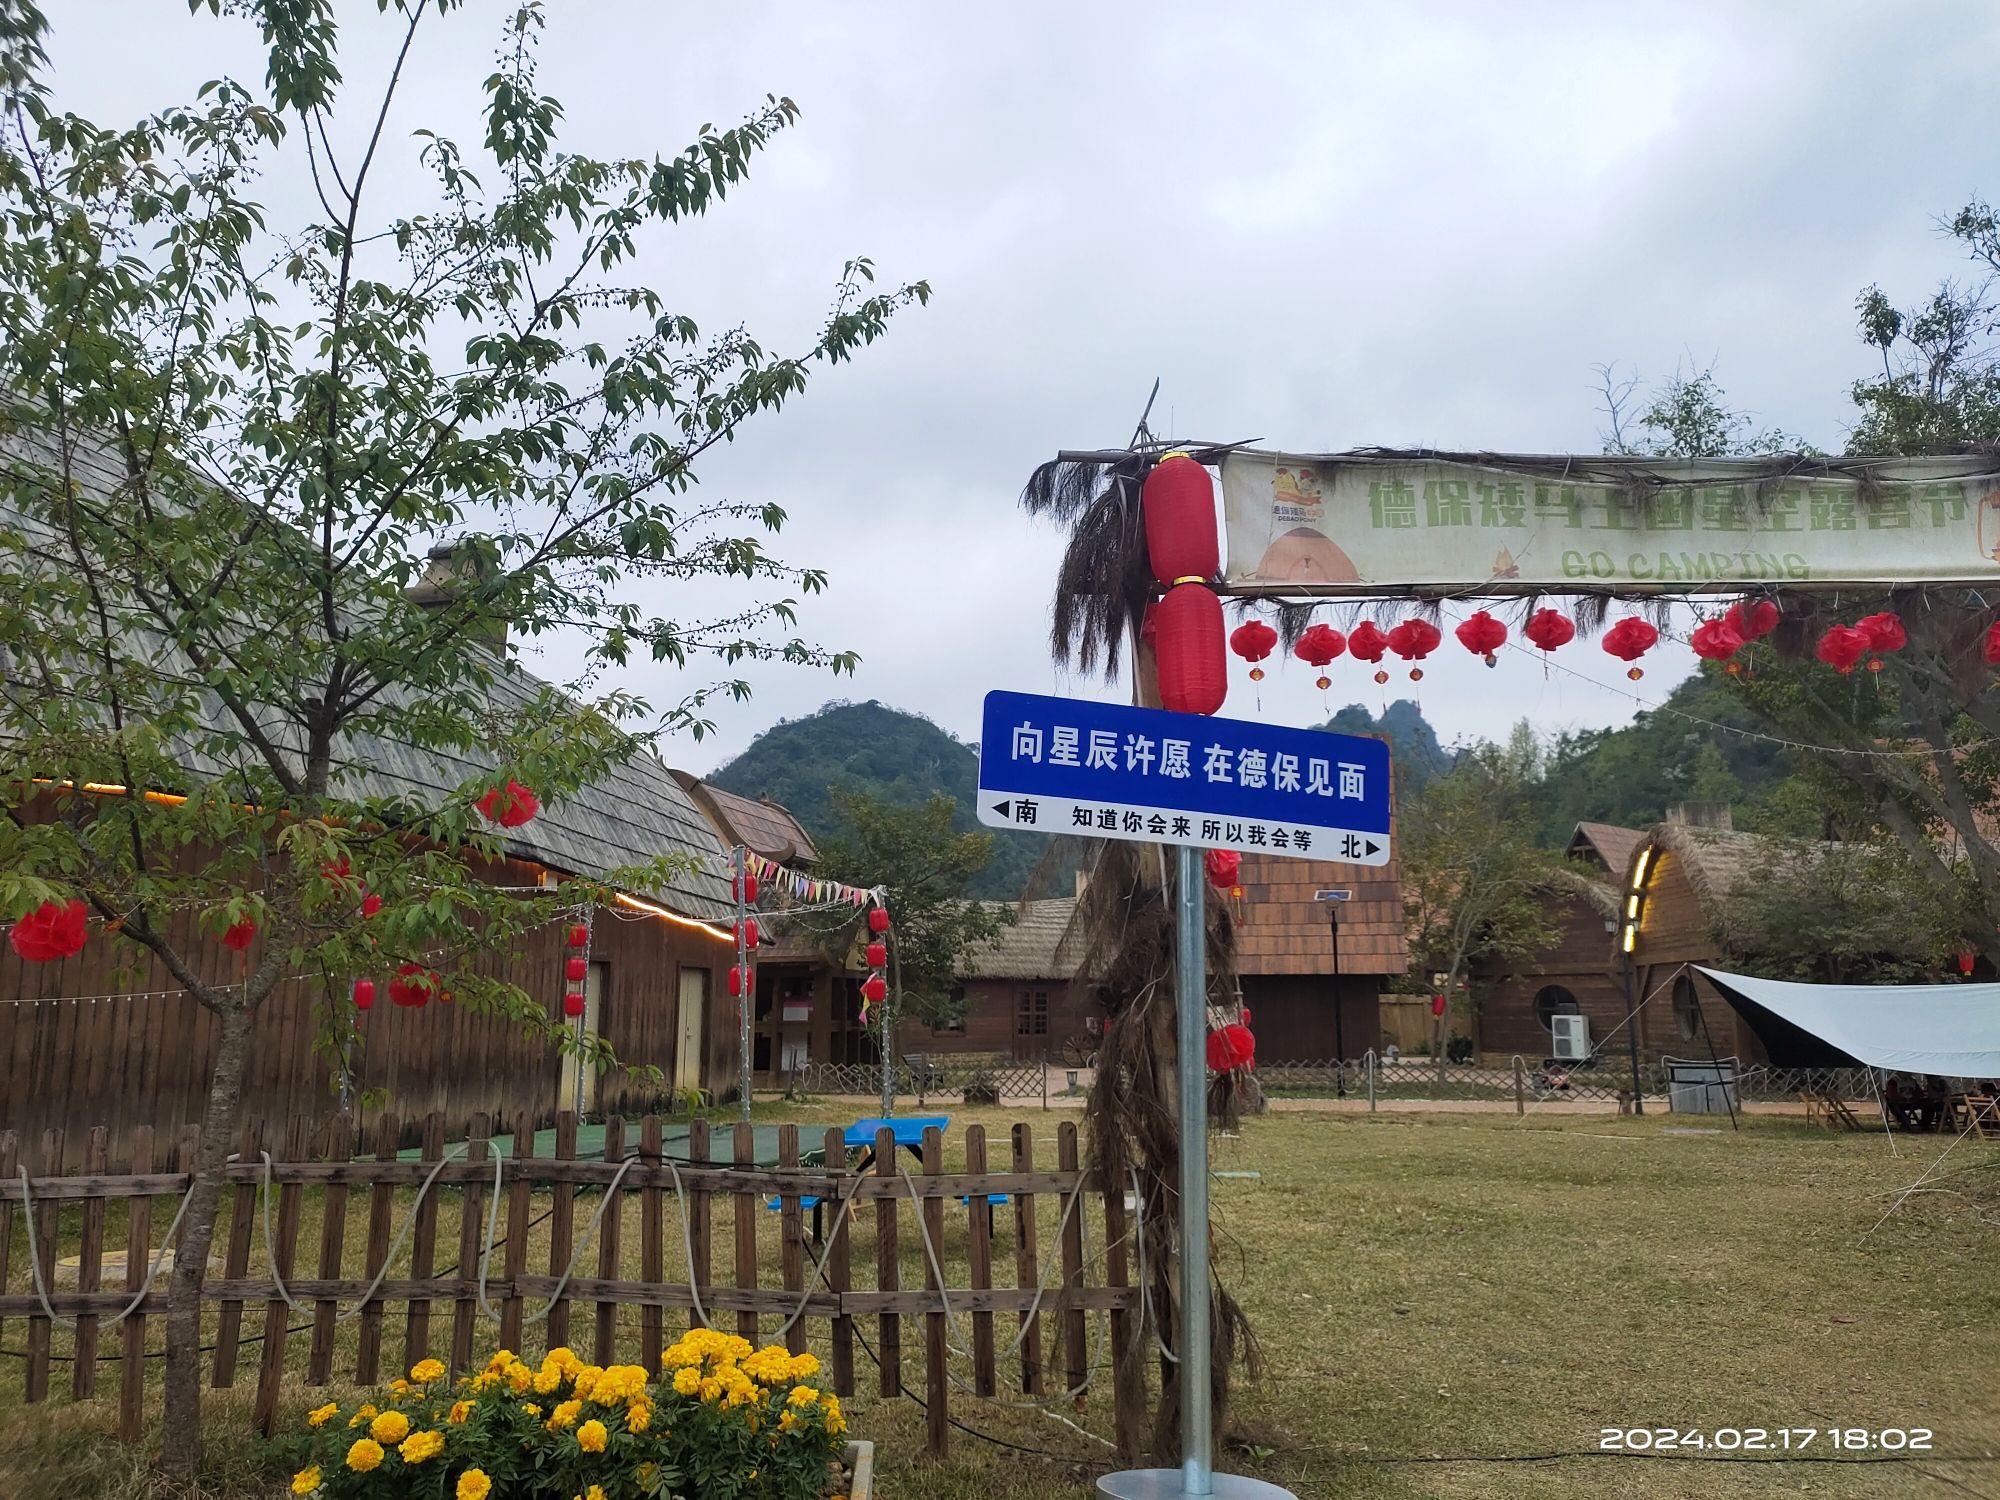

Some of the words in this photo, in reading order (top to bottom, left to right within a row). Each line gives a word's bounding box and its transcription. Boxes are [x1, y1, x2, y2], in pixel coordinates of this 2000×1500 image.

[1561, 550, 1616, 579] GO
[1627, 551, 1811, 581] CAMPING
[1011, 720, 1192, 779] 向星辰许愿
[1203, 743, 1367, 801] 在德保见面
[1015, 799, 1038, 825] 南
[1072, 805, 1192, 837] 知道你会来
[1201, 819, 1312, 852] 所以我会等
[1341, 834, 1362, 859] 北
